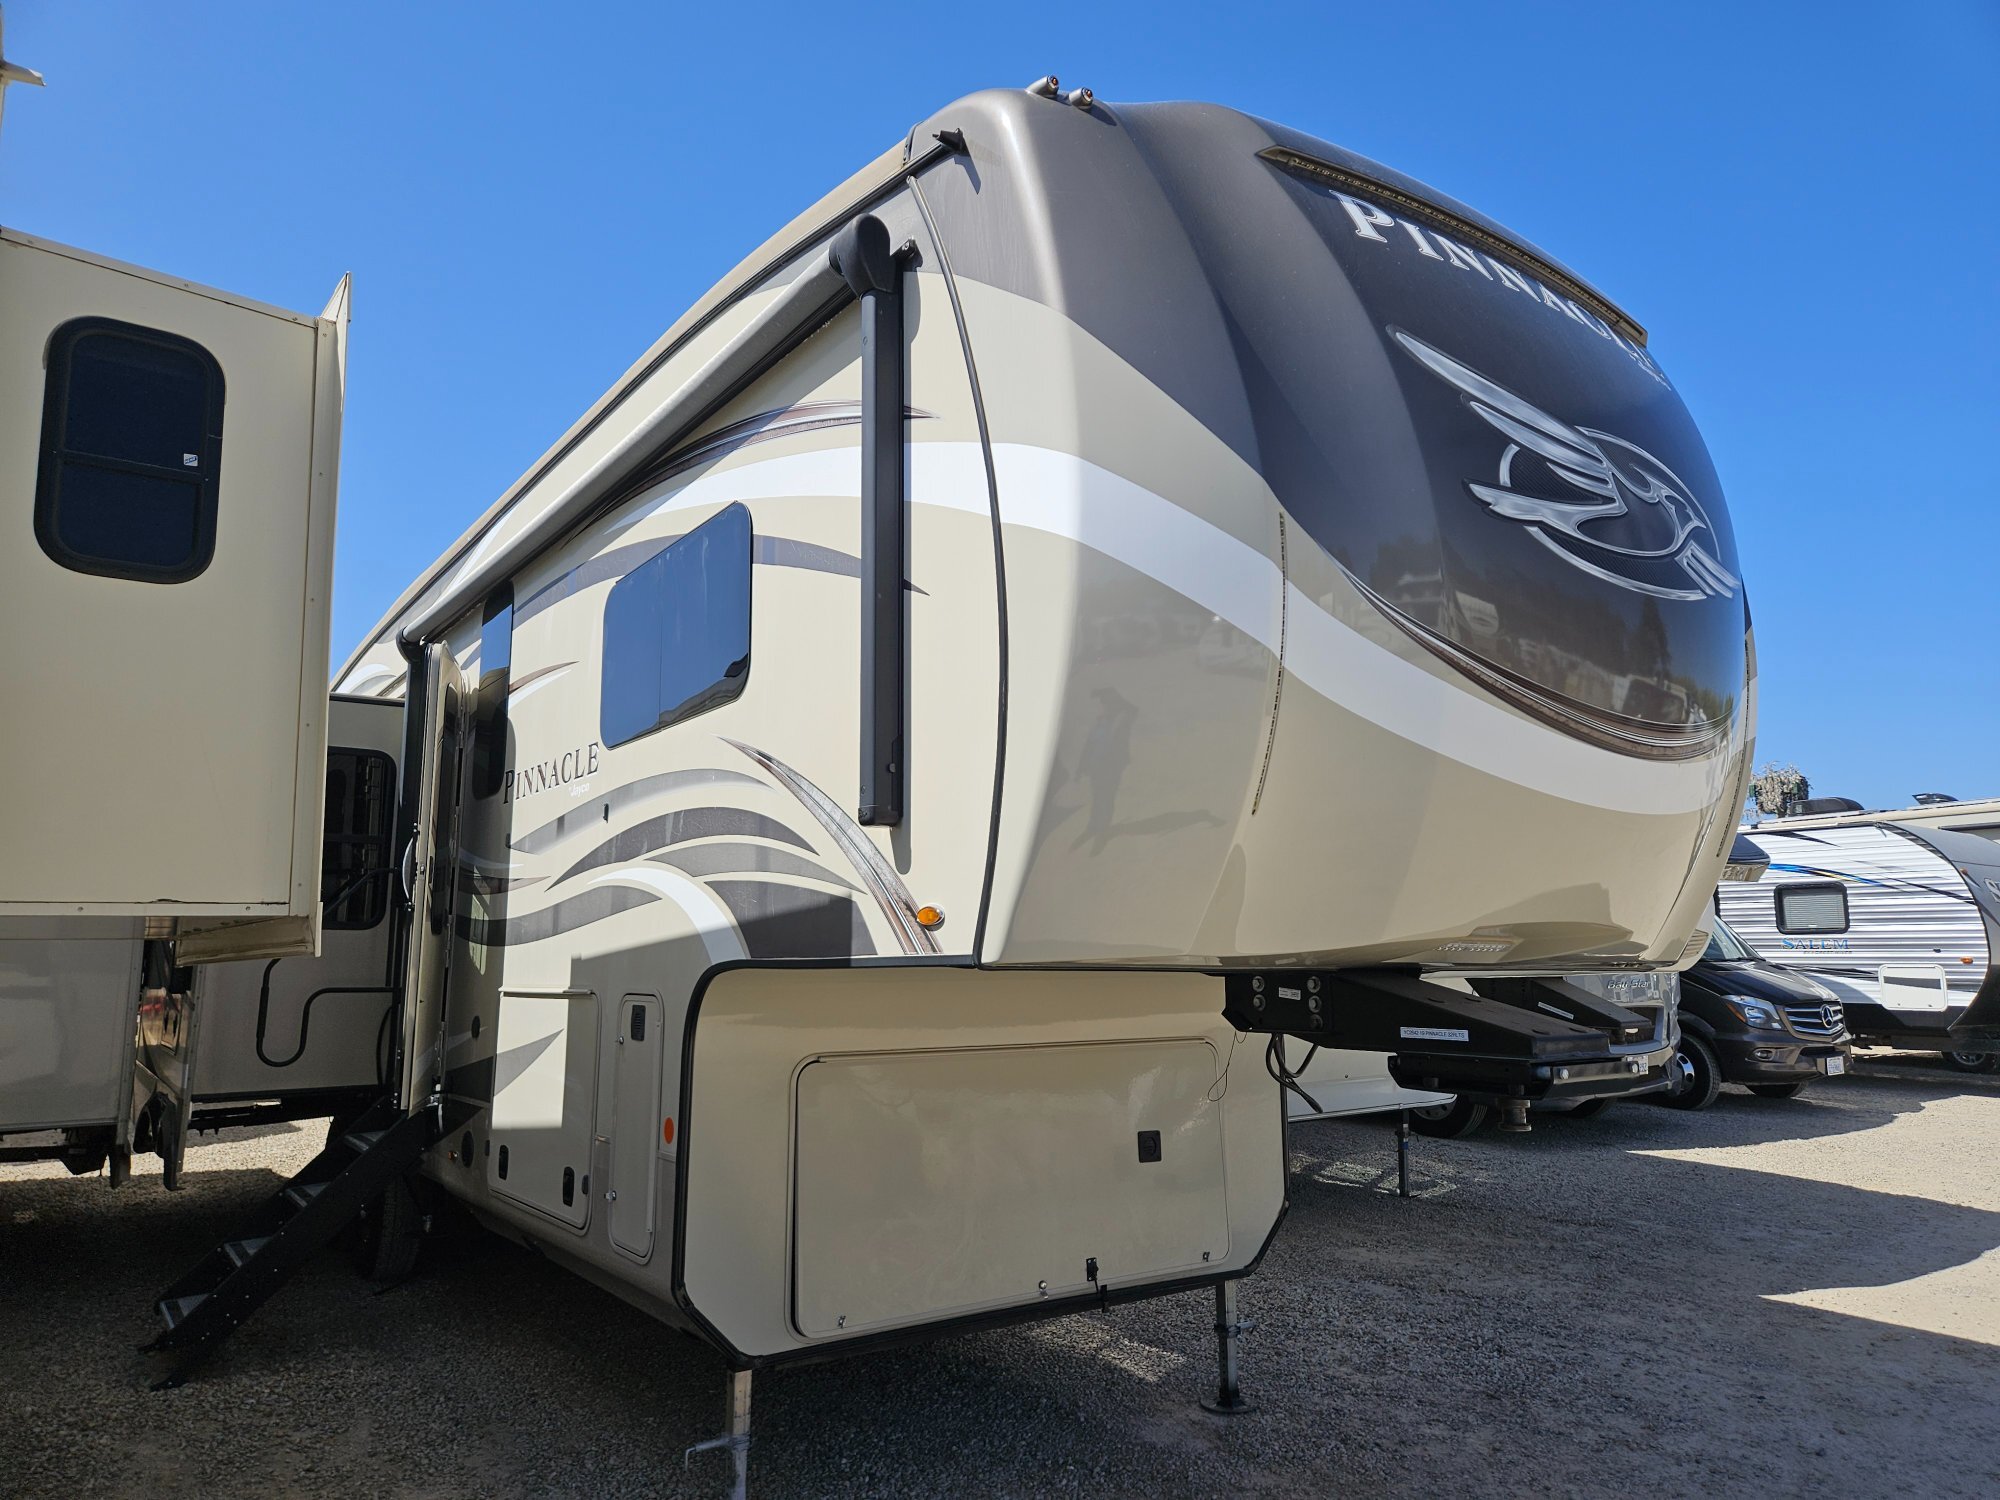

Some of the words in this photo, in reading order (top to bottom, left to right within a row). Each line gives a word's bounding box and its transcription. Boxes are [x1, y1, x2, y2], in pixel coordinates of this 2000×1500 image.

[503, 741, 600, 804] PINNACLE
[1782, 938, 1850, 950] SALEM
[1607, 980, 1628, 991] Bay
[1630, 979, 1649, 988] Star
